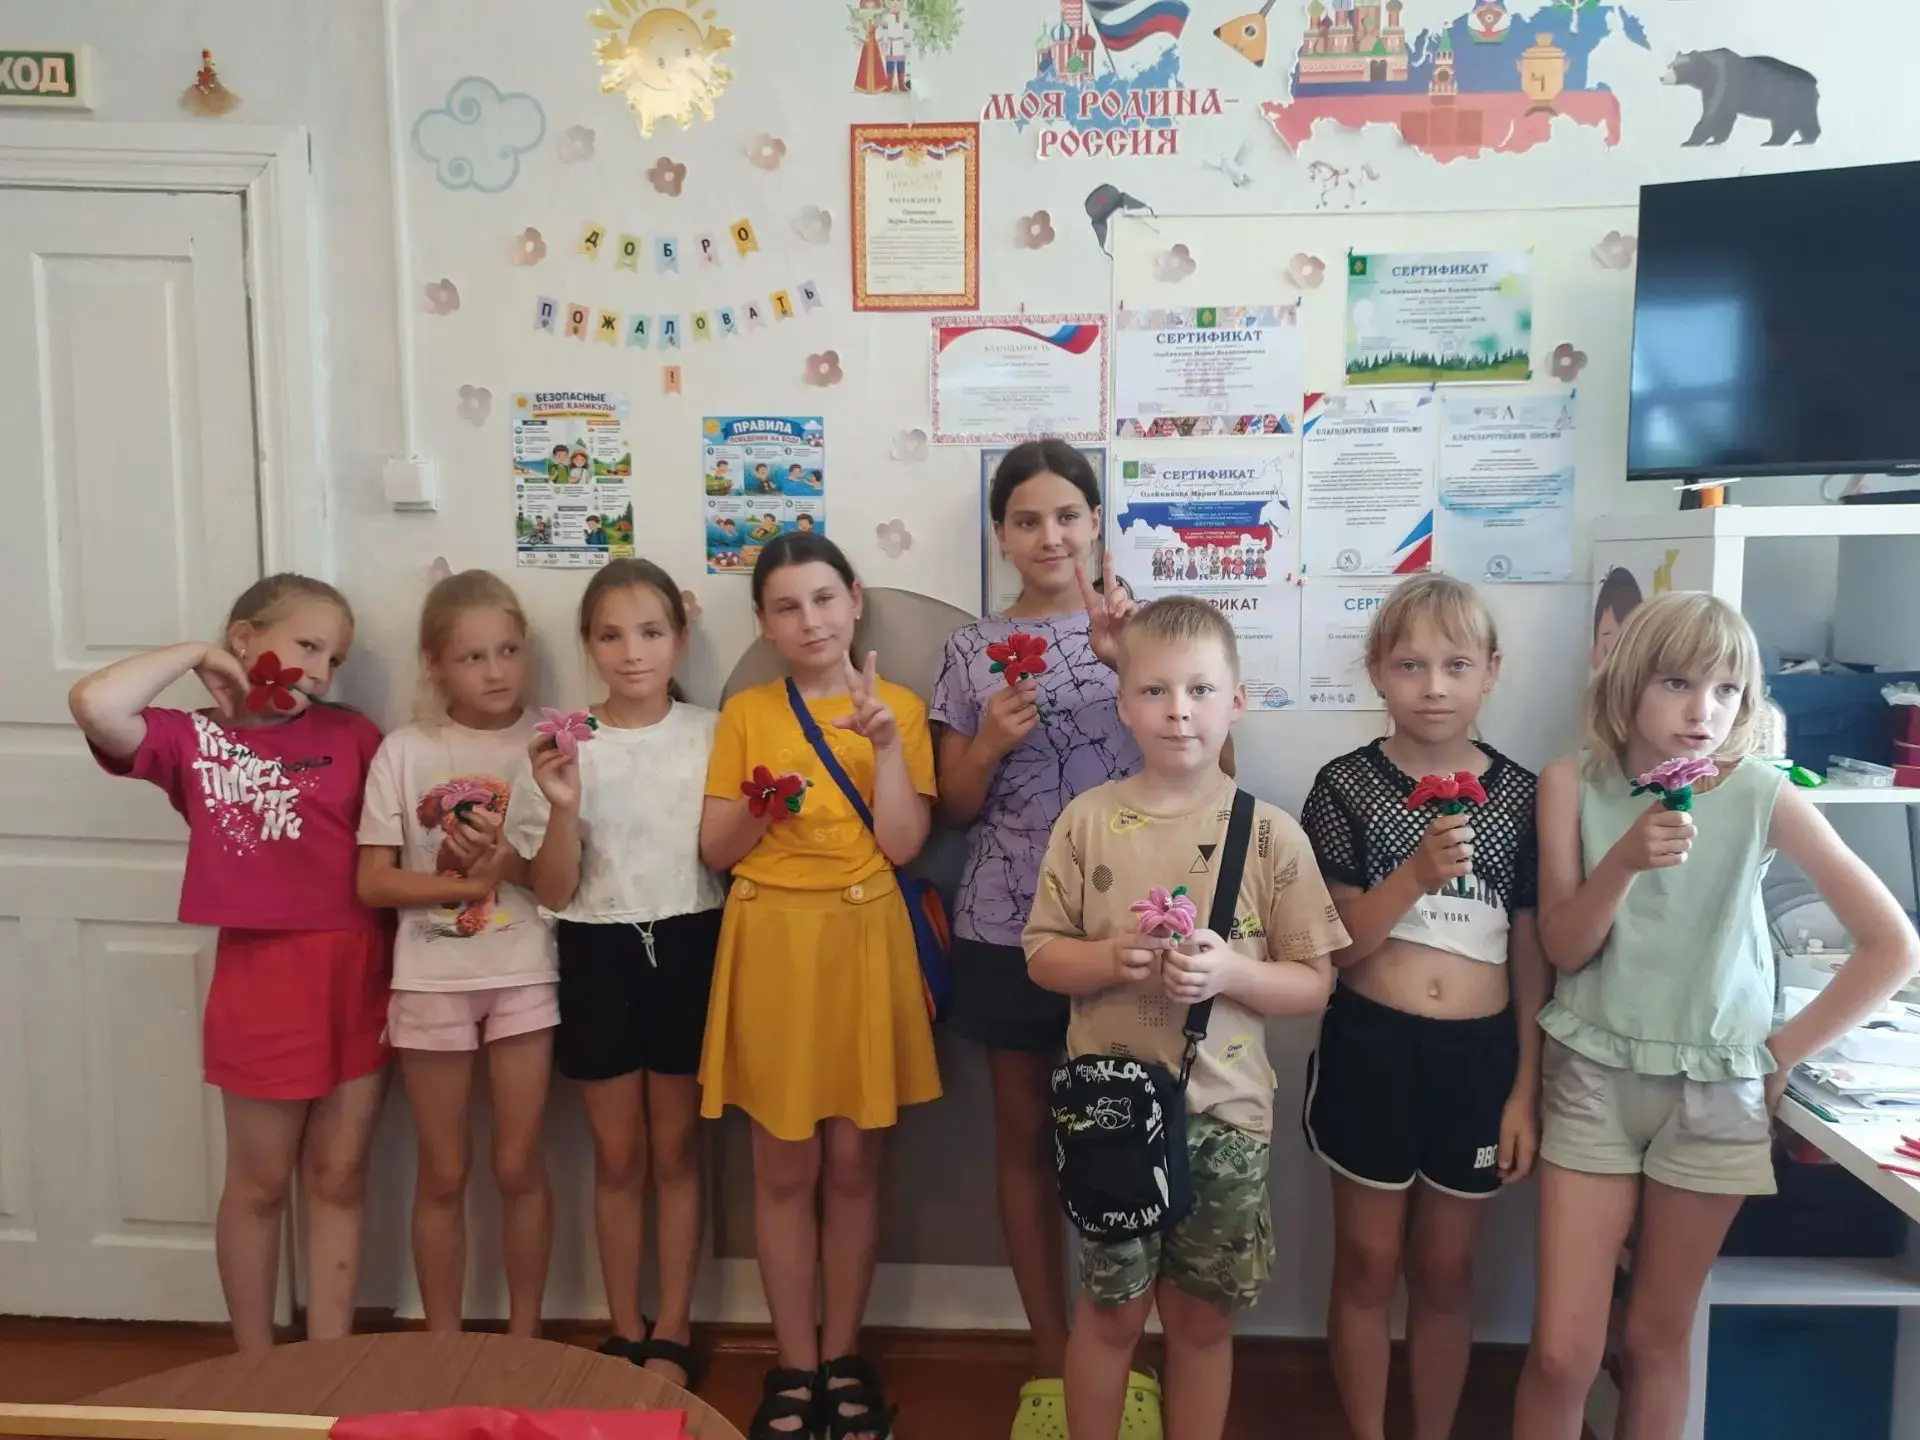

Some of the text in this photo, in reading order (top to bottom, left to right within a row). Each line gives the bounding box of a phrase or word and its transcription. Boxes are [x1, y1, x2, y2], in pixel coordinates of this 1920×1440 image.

[983, 92, 1064, 121] МОЯ
[1040, 128, 1179, 157] РОССИЯ
[584, 226, 750, 258] ДОБРО
[1392, 263, 1488, 277] СЕРТИФИКАТ
[541, 287, 815, 336] ПОЖАЛОВАТЬ
[1156, 330, 1263, 344] СЕРТИФИКАТ
[535, 392, 606, 403] БЕЗОПАСНЫЕ
[733, 420, 792, 434] ПРАВИЛА
[1163, 469, 1256, 481] СЕРТИФИКАТ
[1258, 819, 1267, 858] MAKERS
[1443, 911, 1471, 923] YORK
